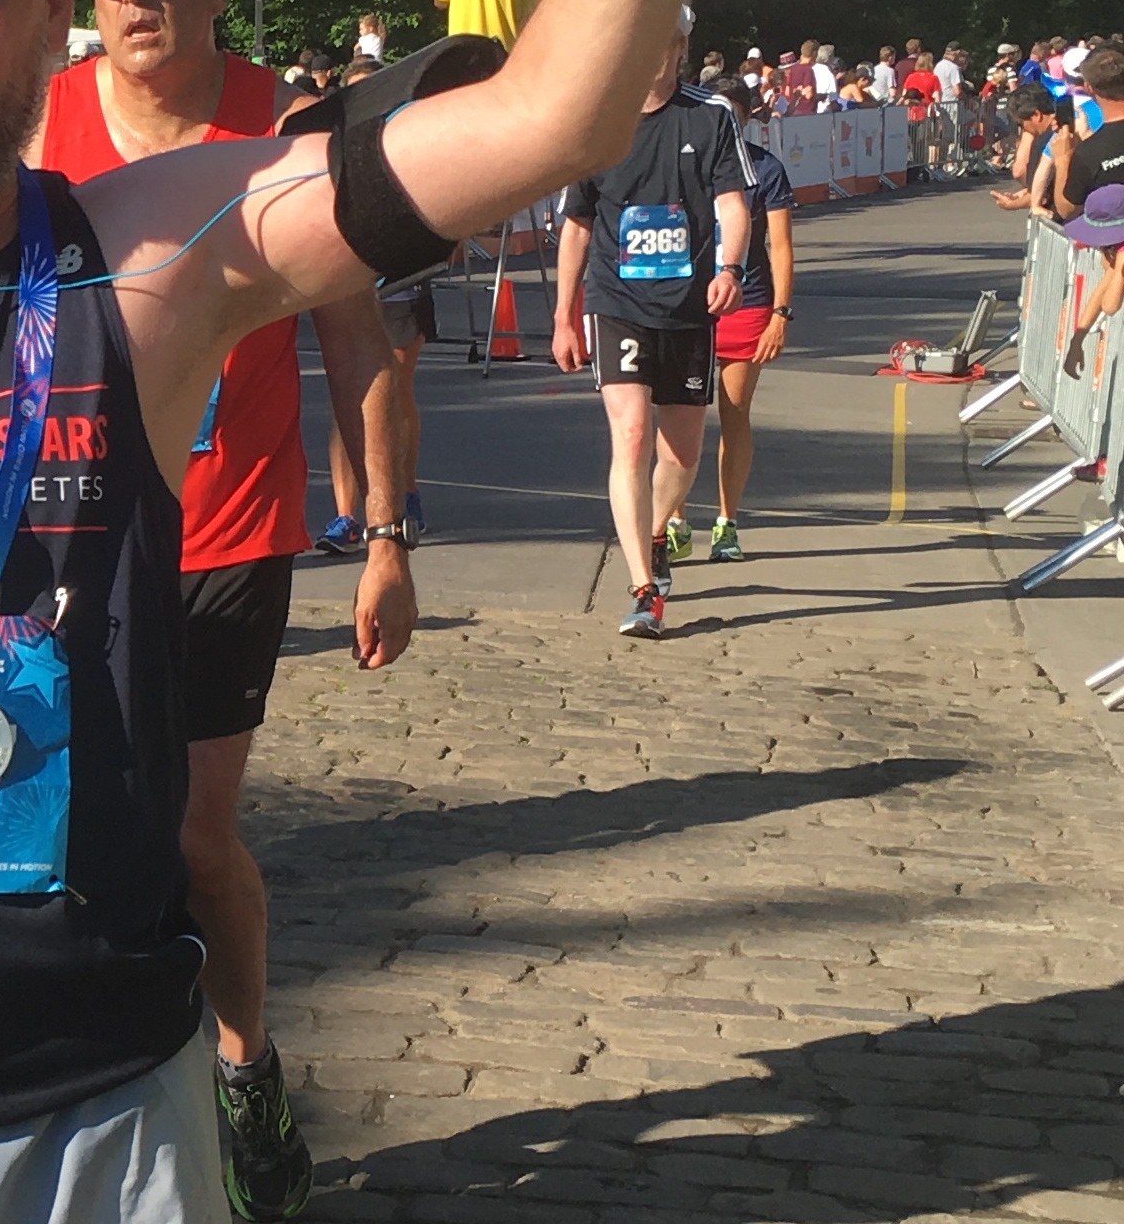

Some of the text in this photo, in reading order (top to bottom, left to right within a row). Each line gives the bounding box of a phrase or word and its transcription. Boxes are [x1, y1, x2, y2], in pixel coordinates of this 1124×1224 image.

[626, 228, 688, 255] 2363
[620, 338, 640, 372] 2
[9, 863, 19, 871] IN
[20, 863, 54, 872] MOTION
